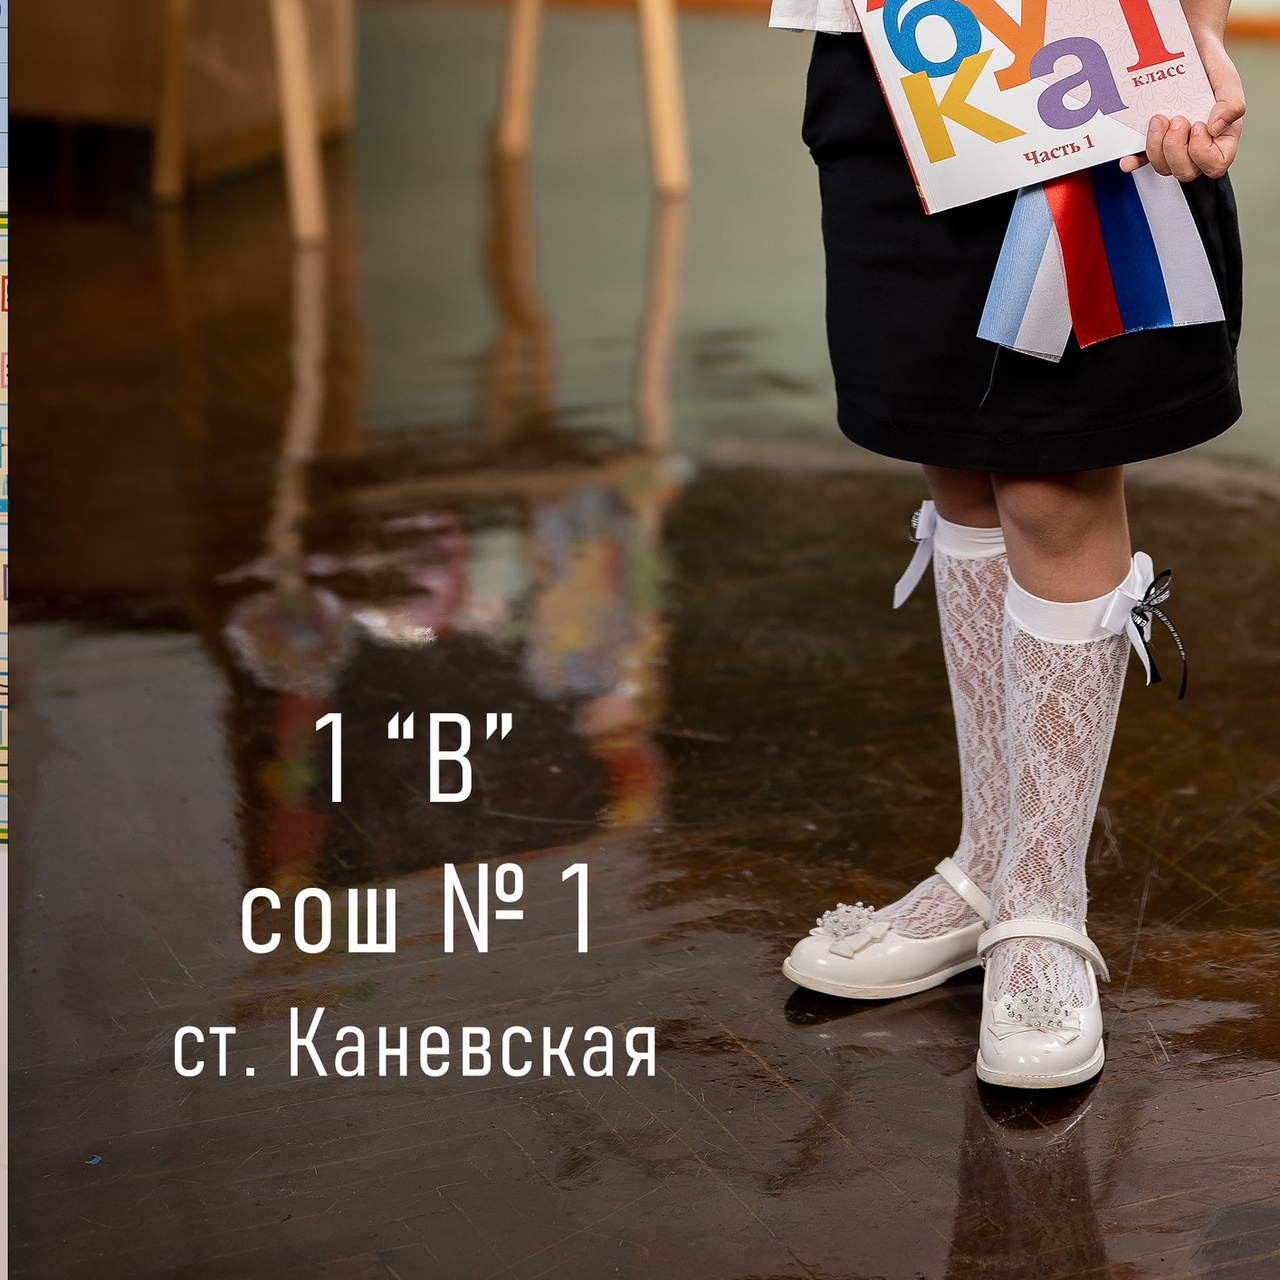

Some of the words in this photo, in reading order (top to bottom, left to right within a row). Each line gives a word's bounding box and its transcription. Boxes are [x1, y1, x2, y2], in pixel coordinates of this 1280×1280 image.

[1131, 63, 1186, 88] класс
[1023, 141, 1081, 166] Часть
[1083, 134, 1095, 149] 1
